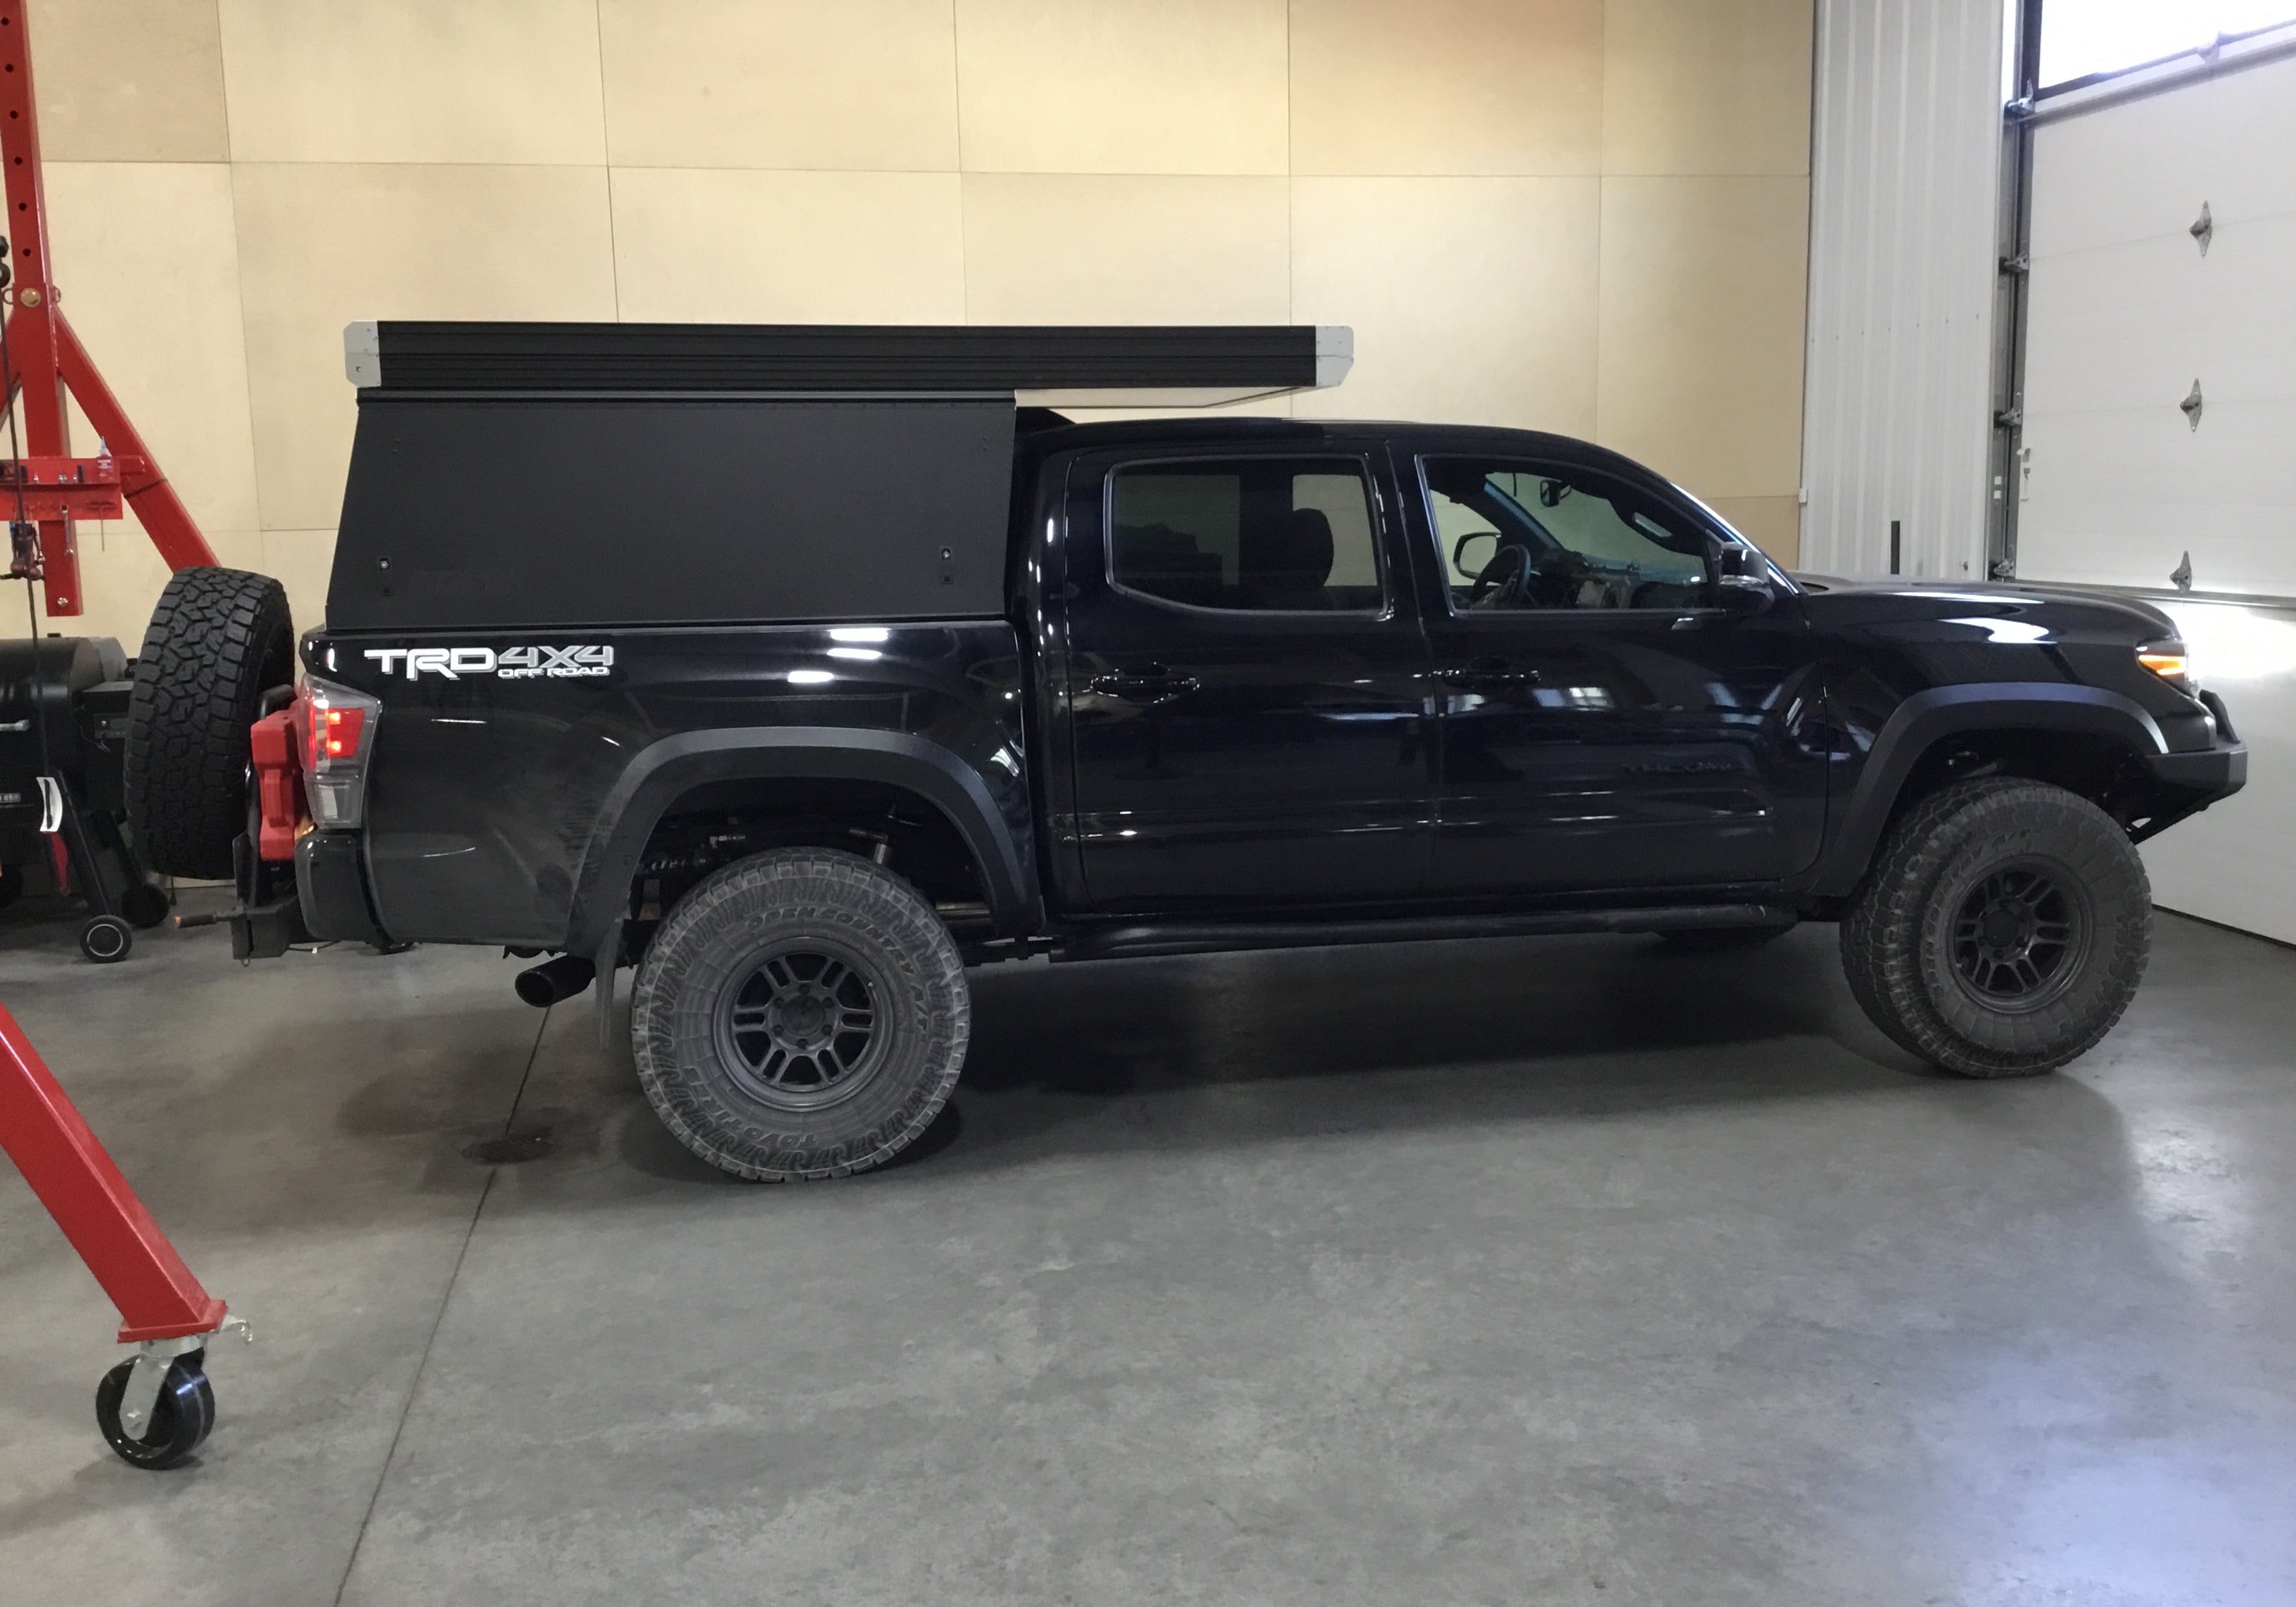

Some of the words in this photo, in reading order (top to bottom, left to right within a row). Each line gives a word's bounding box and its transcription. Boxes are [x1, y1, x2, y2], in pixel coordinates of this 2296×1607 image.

[364, 647, 497, 681] TRD
[498, 644, 614, 668] 4X4
[498, 667, 544, 679] OFF
[546, 666, 610, 678] ROAD
[748, 906, 816, 931] OPEN
[819, 908, 915, 976] COUNTRY
[683, 1067, 743, 1129] TIRES
[743, 1126, 817, 1148] TOYO
